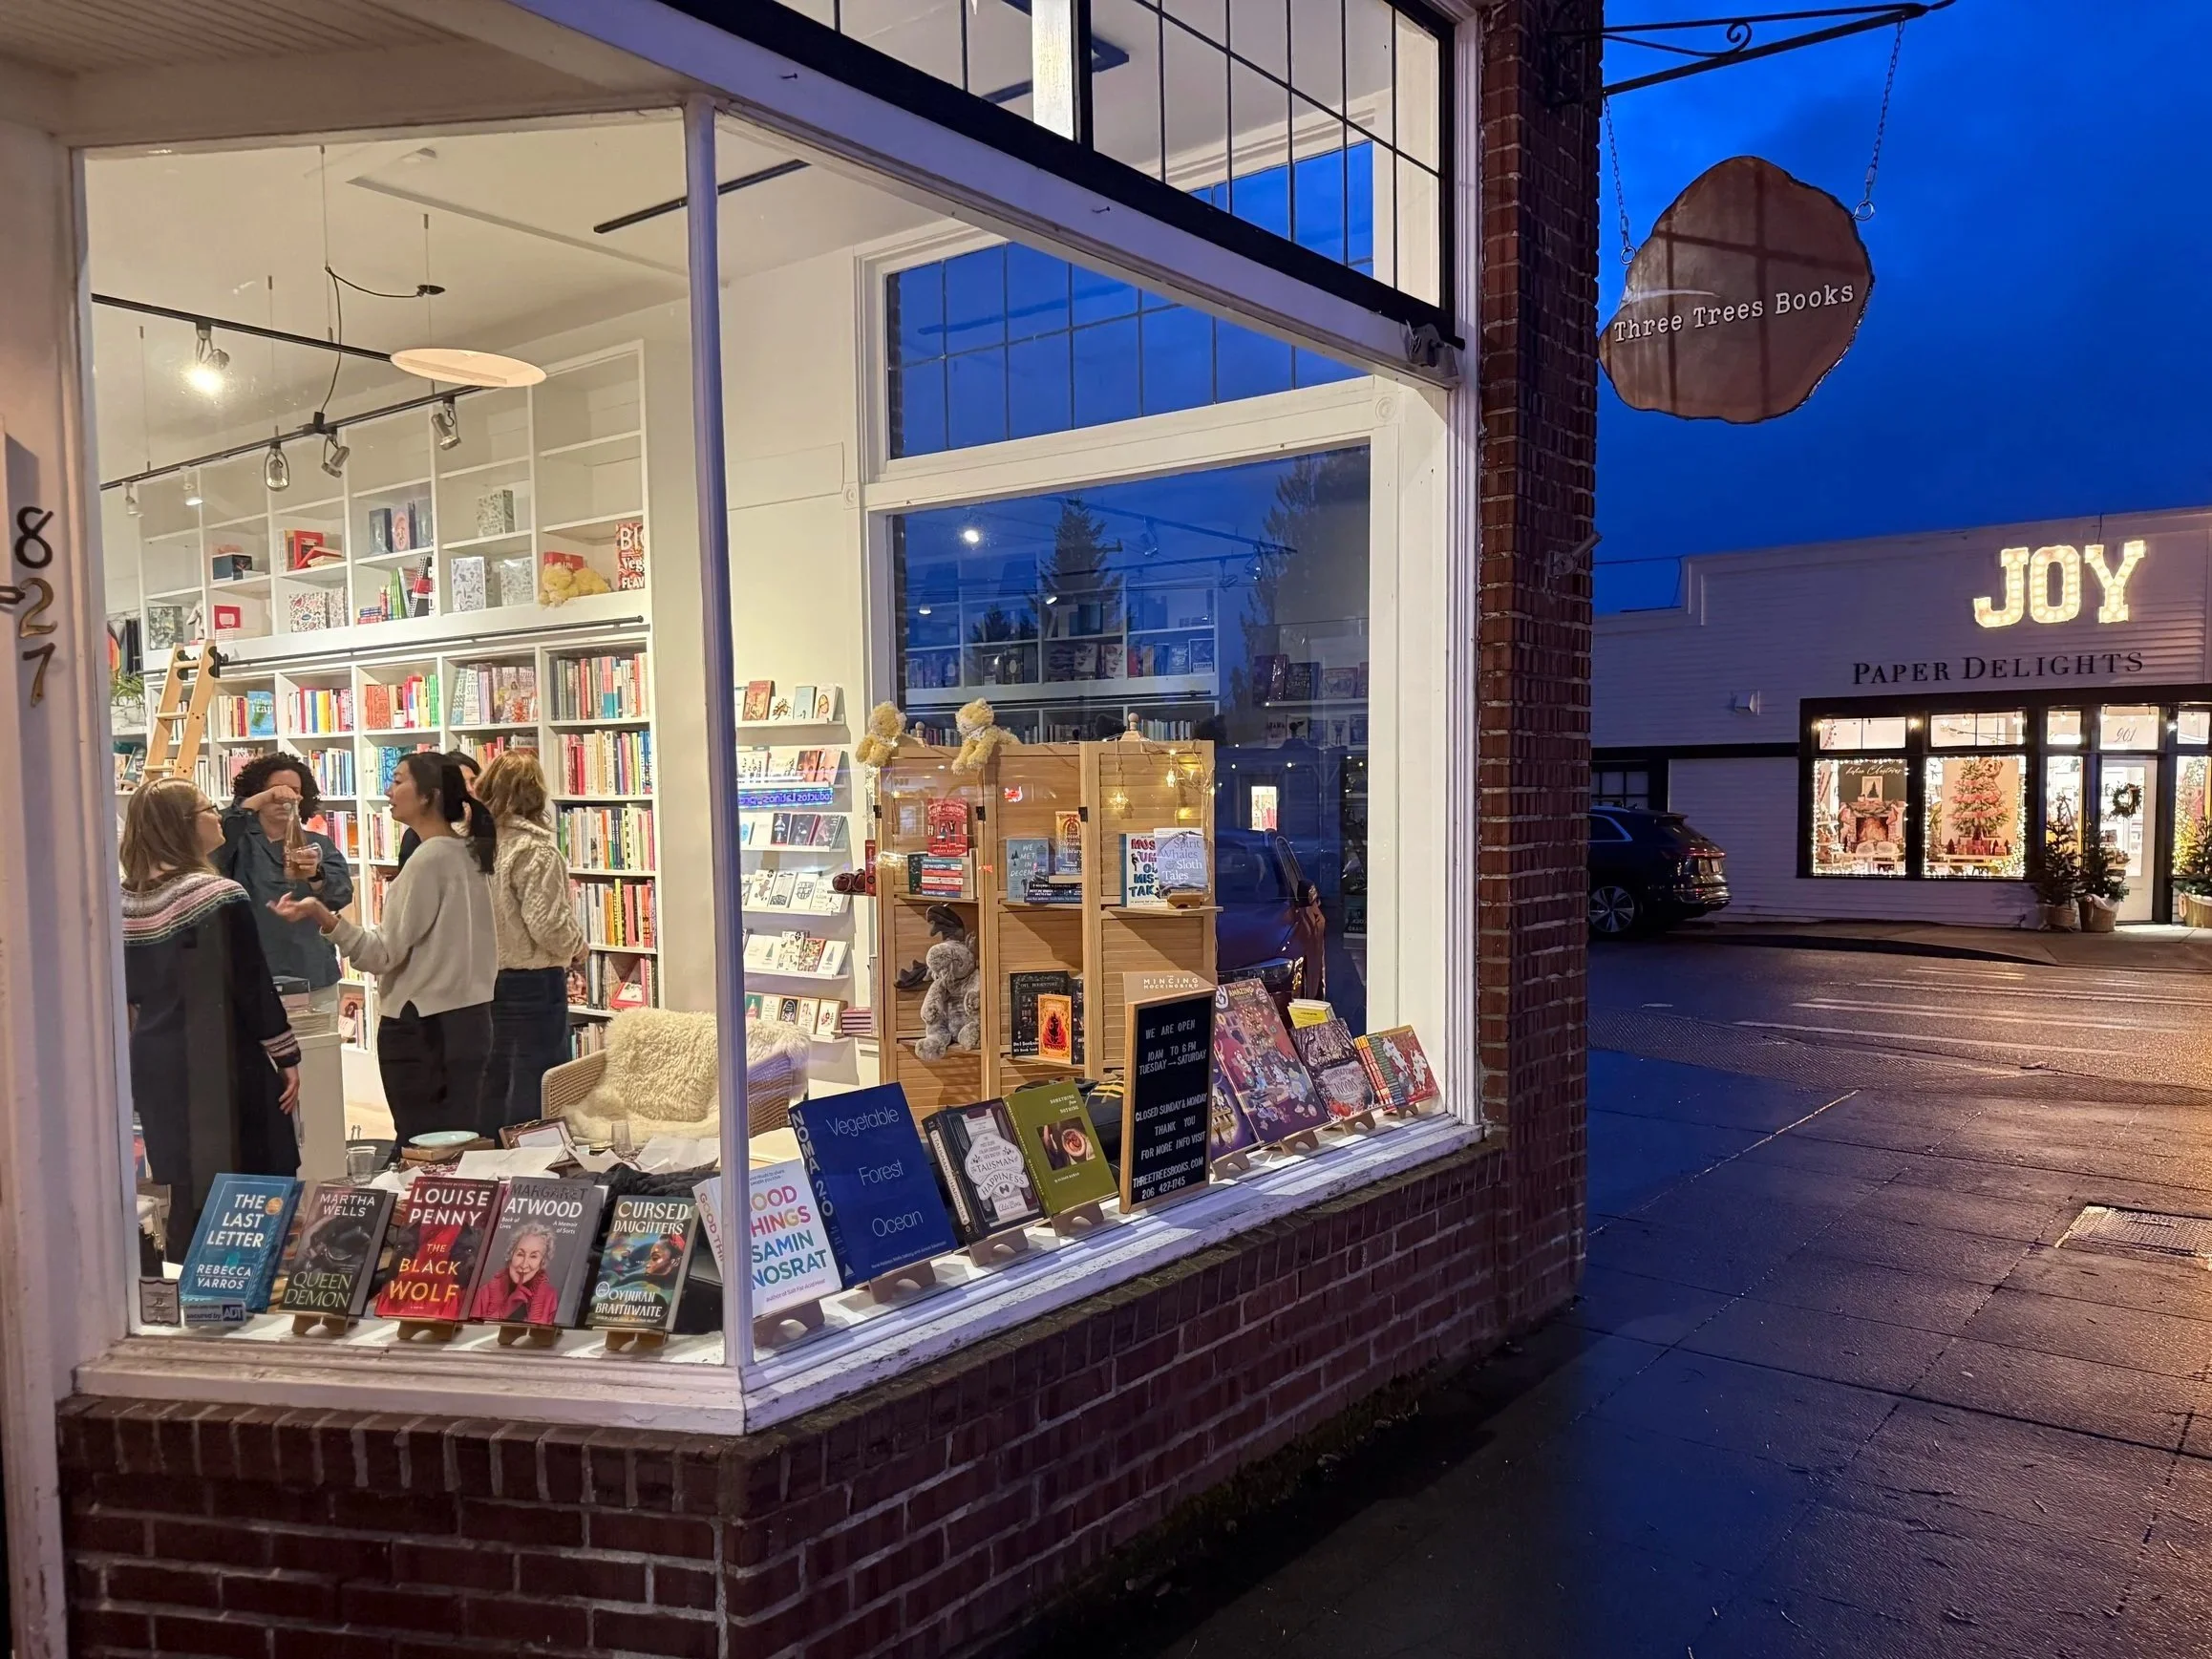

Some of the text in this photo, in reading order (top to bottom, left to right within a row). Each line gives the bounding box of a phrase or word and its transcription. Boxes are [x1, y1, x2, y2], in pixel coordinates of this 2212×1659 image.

[1614, 284, 1855, 343] Three Trees Books
[1973, 540, 2147, 628] JOY
[1853, 651, 2144, 685] PAPER DELIGHTS
[2114, 727, 2138, 743] 901
[1022, 842, 1033, 851] WE
[1174, 839, 1201, 850] Spirit
[1160, 849, 1198, 859] Whales
[1177, 859, 1202, 869] Sloth
[1162, 870, 1189, 880] Tales
[1145, 1019, 1196, 1039] WE ARE OPEN
[1170, 1045, 1180, 1056] TO
[825, 1106, 900, 1137] Vegetable
[1135, 1106, 1159, 1122] CLOSED
[1154, 1116, 1196, 1136] THANK YOU
[791, 1110, 820, 1175] NOMA
[1140, 1131, 1206, 1160] FOR MORE INFO VISIT
[859, 1159, 904, 1186] Forest
[977, 1157, 1015, 1173] TALISMAN
[511, 1184, 588, 1201] MARGARET
[981, 1172, 1025, 1196] HAPPINESS
[320, 1193, 375, 1206] MARTHA
[413, 1187, 490, 1207] LOUISE
[750, 1185, 798, 1212] OOD
[1141, 1186, 1155, 1200] 206
[234, 1194, 266, 1210] THE
[504, 1197, 583, 1218] ATWOOD
[323, 1206, 366, 1217] WELLS
[409, 1208, 482, 1227] PENNY
[617, 1201, 689, 1221] CURSED
[699, 1193, 717, 1234] GOOD
[222, 1212, 265, 1229] LAST
[613, 1221, 684, 1235] DAUGHTERS
[751, 1205, 812, 1237] HINGS
[871, 1210, 924, 1238] Ocean
[206, 1231, 265, 1248] LETTER
[752, 1229, 815, 1264] SAMIN
[426, 1244, 448, 1253] THE
[197, 1265, 252, 1277] REBECCA
[399, 1258, 461, 1275] BLACK
[752, 1249, 827, 1290] NOSRAT
[197, 1278, 245, 1289] YARROS
[293, 1271, 352, 1289] QUEEN
[284, 1289, 351, 1308] DEMON
[389, 1280, 459, 1303] WOLF
[608, 1289, 656, 1303] OYINKAN
[223, 1307, 244, 1319] ADT
[595, 1302, 663, 1317] BRAITHWAITE
